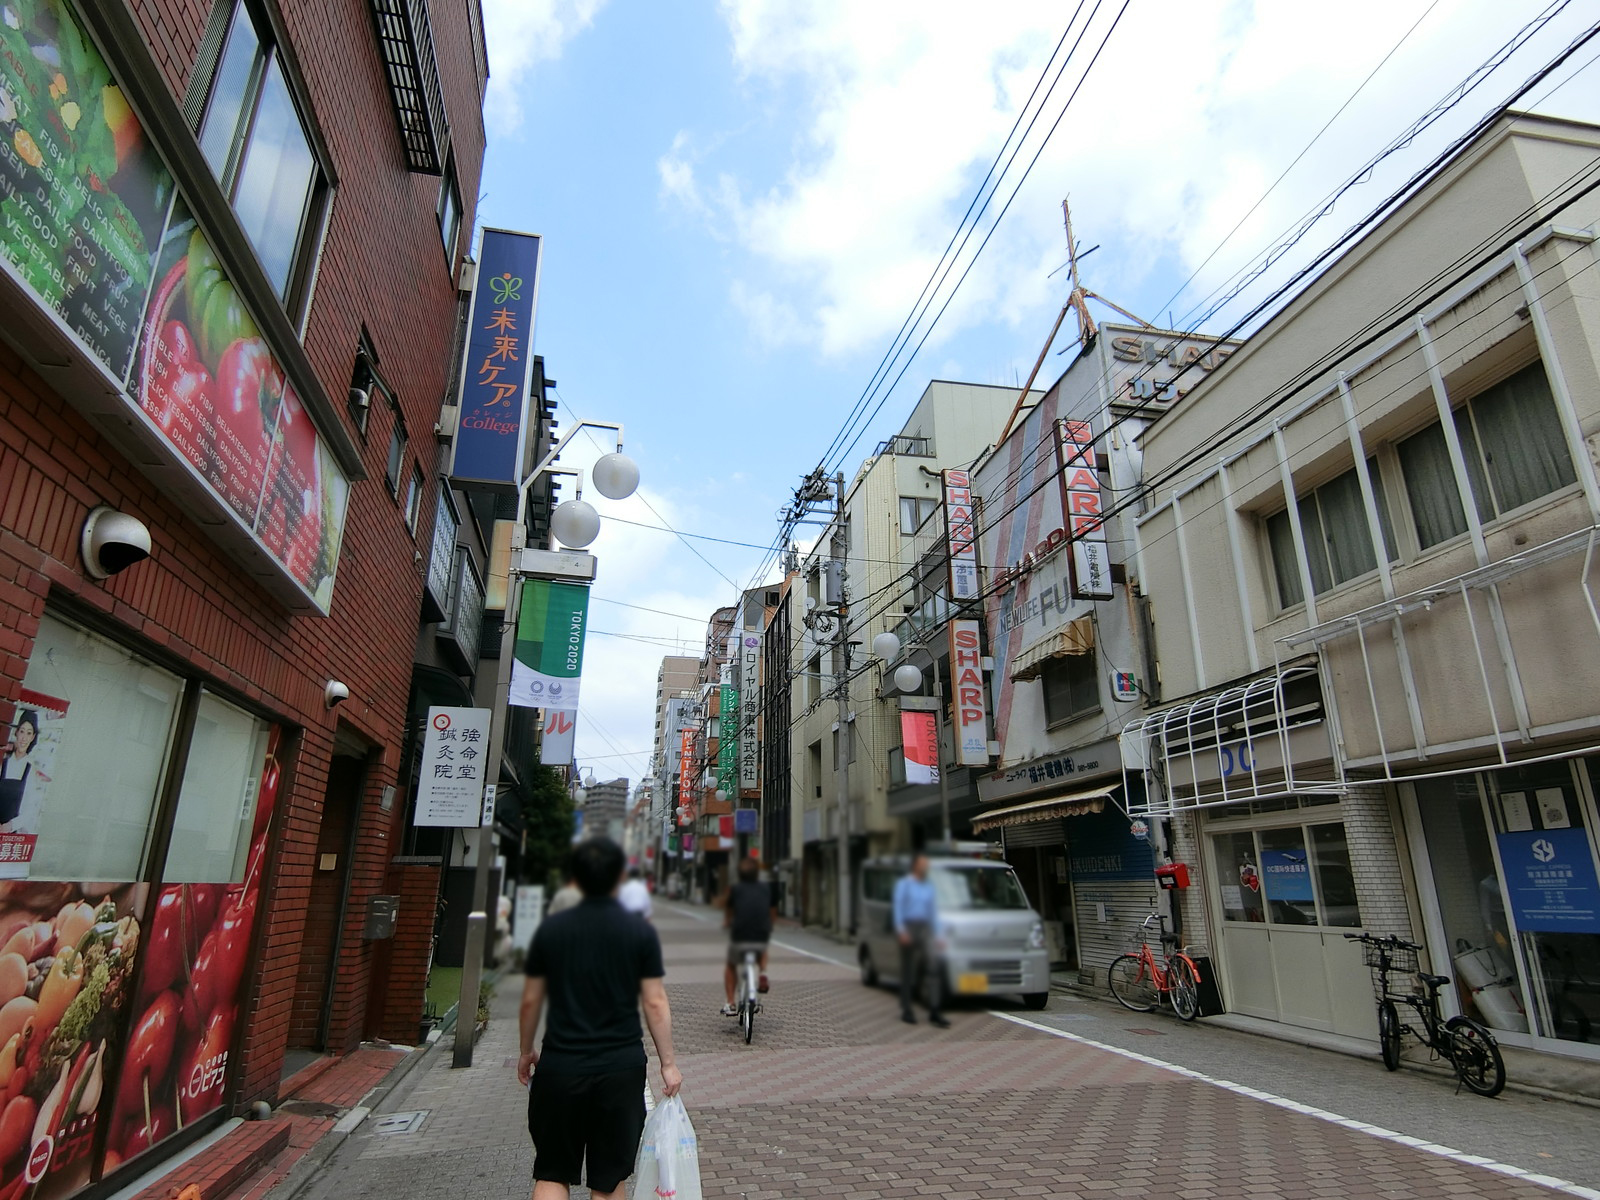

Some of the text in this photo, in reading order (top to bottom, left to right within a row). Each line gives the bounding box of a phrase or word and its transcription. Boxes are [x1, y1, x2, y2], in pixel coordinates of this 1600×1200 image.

[40, 129, 66, 168] FISH
[73, 176, 140, 274] DELICATESSEN
[6, 214, 110, 338] VEGETABLE MEAT
[36, 186, 97, 267] DAILYFOOD
[104, 273, 129, 309] FRUIT
[67, 255, 97, 295] FRUIT
[82, 217, 133, 288] DAILYFOOD
[43, 288, 69, 323] FISH
[479, 306, 520, 408] 未来ケア
[1111, 337, 1233, 373] SHA
[200, 392, 214, 415] FISH
[462, 416, 519, 435] College
[172, 429, 208, 472] DAILYFOOD
[1064, 420, 1103, 537] SHARP
[947, 471, 973, 560] SHARP
[566, 610, 583, 671] TOKYO 2020
[955, 630, 983, 727] SHARP
[545, 711, 573, 735] ル
[743, 653, 756, 780] ロイヤル商事株式会社
[434, 728, 457, 779] 鍼灸院
[456, 728, 481, 780] 強命堂
